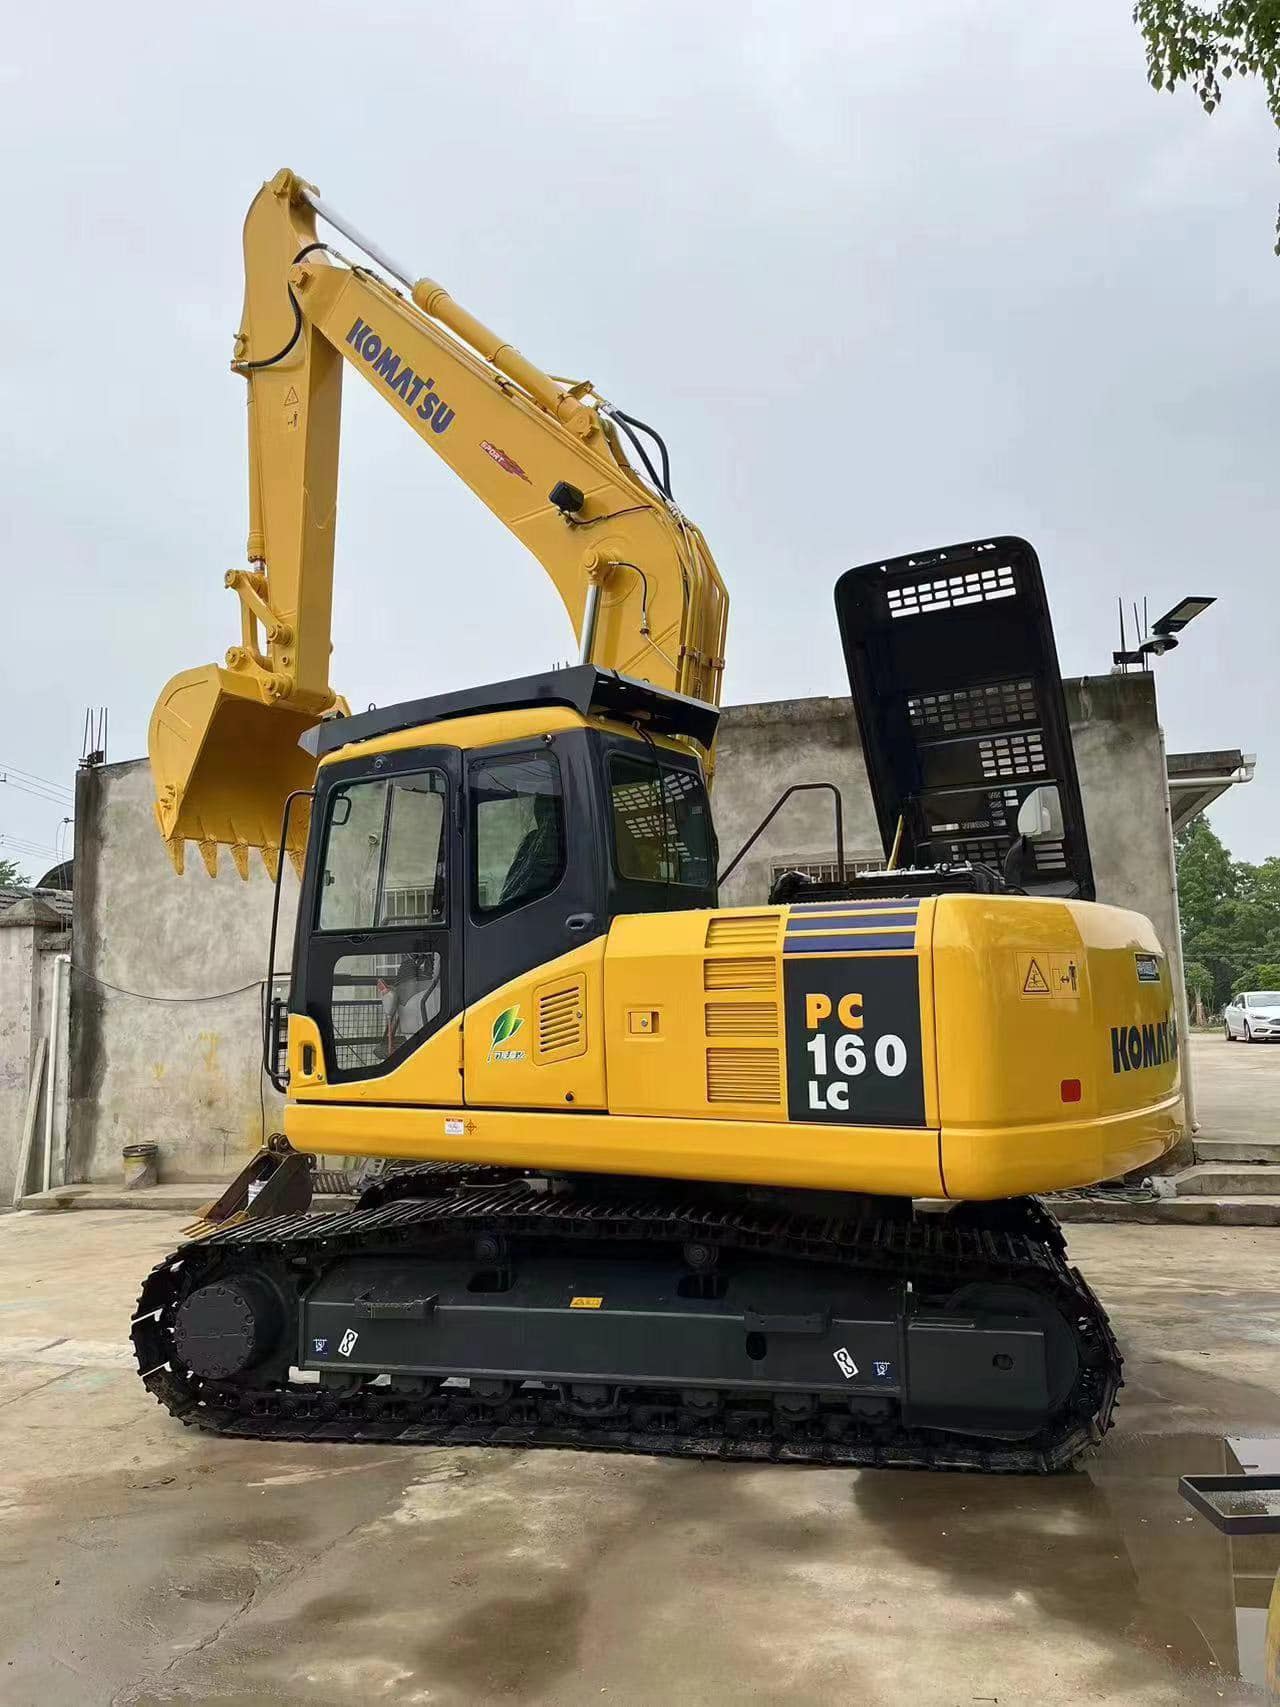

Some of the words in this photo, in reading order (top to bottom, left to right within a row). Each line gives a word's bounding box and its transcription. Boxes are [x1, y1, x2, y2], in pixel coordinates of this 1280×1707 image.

[345, 316, 456, 434] KOMATSU
[481, 441, 505, 462] SPORT
[805, 993, 864, 1030] PC
[807, 1033, 908, 1077] 160
[808, 1080, 850, 1110] LC
